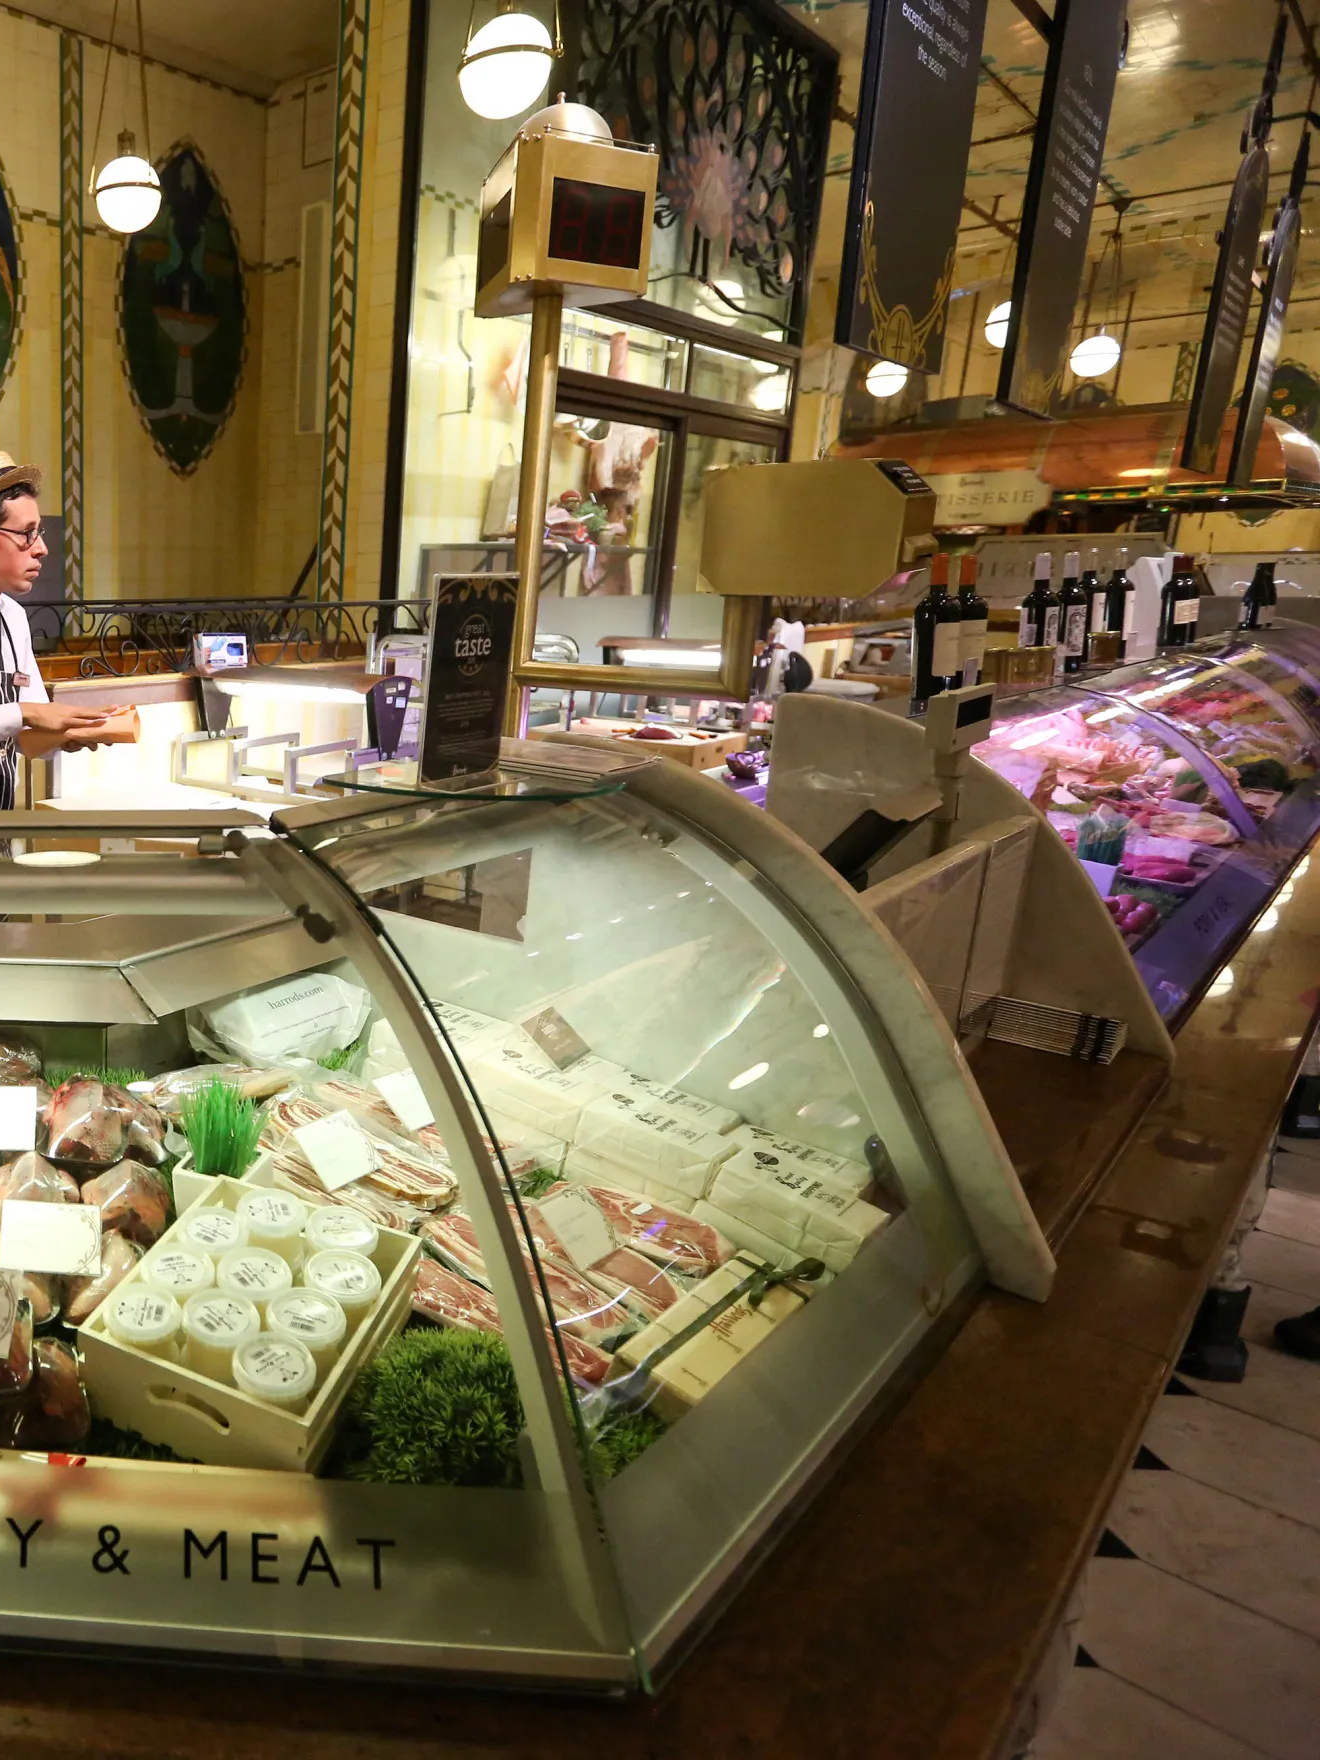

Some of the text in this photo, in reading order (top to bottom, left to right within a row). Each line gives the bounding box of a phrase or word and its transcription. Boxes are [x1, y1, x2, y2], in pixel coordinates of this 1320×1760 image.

[901, 3, 935, 43] exceptional
[934, 31, 961, 64] regardless
[464, 623, 486, 638] great
[454, 636, 493, 657] taste
[267, 985, 325, 1010] harrods.com
[92, 1524, 130, 1576] &
[183, 1527, 397, 1590] MEAT
